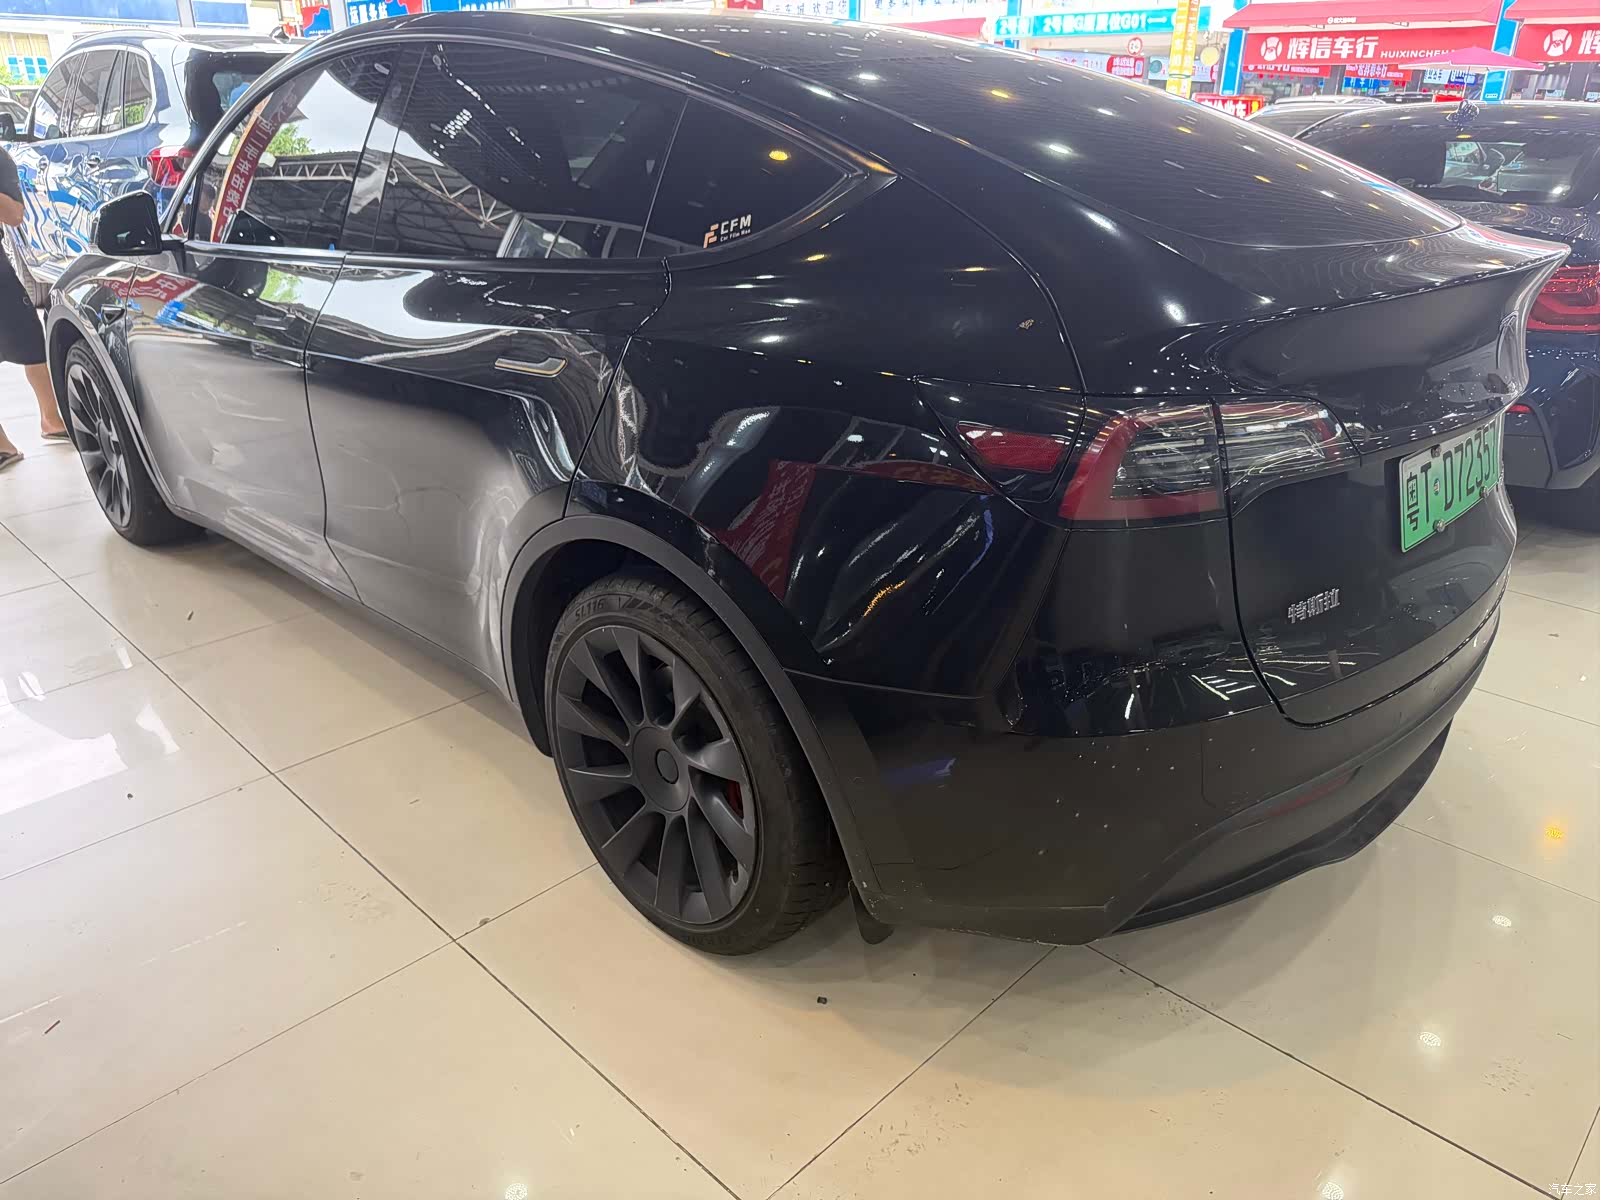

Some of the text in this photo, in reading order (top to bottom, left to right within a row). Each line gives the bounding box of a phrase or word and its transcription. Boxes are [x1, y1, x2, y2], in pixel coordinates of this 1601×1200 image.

[1287, 36, 1379, 60] 辉信车行
[1380, 48, 1455, 59] HUIXINCHE
[720, 214, 752, 234] CFM
[1288, 588, 1341, 624] 特斯拉
